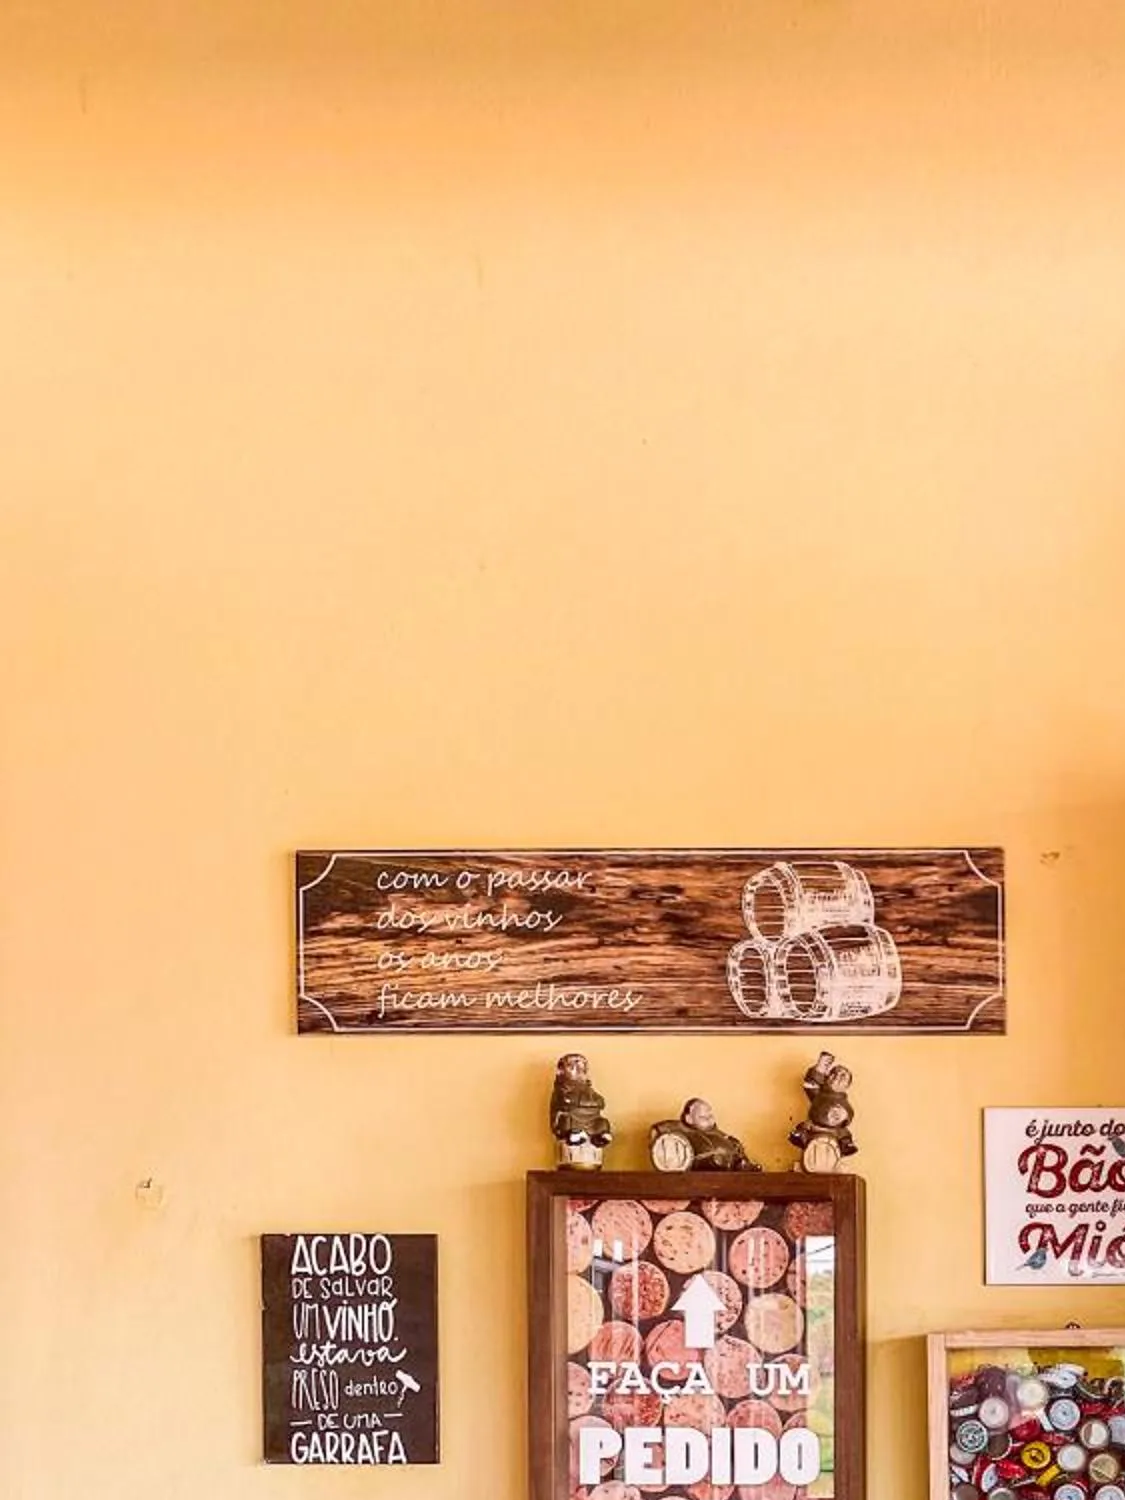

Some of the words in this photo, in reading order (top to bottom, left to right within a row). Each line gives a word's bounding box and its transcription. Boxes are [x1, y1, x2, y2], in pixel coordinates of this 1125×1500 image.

[377, 870, 449, 890] com
[456, 871, 480, 890] o
[487, 870, 593, 896] passar
[377, 903, 438, 932] dos
[444, 902, 562, 932] vinhos
[377, 951, 412, 971] os
[421, 950, 503, 970] anos
[378, 983, 476, 1018] ficam
[485, 981, 643, 1011] melhores
[1025, 1119, 1039, 1137] é
[1034, 1119, 1096, 1143] junto
[1025, 1202, 1054, 1218] que
[1056, 1203, 1066, 1213] a
[1068, 1200, 1110, 1218] gente
[291, 1234, 392, 1276] ACABO
[292, 1277, 313, 1299] DE
[293, 1301, 320, 1340] UM
[289, 1340, 407, 1367] estava
[292, 1369, 339, 1411] PRESO
[587, 1361, 715, 1403] FAÇA
[746, 1363, 811, 1396] UM
[317, 1413, 339, 1431] DE
[343, 1412, 382, 1430] UMA
[290, 1430, 408, 1464] GARRAFA
[579, 1427, 821, 1486] PEDIDO
